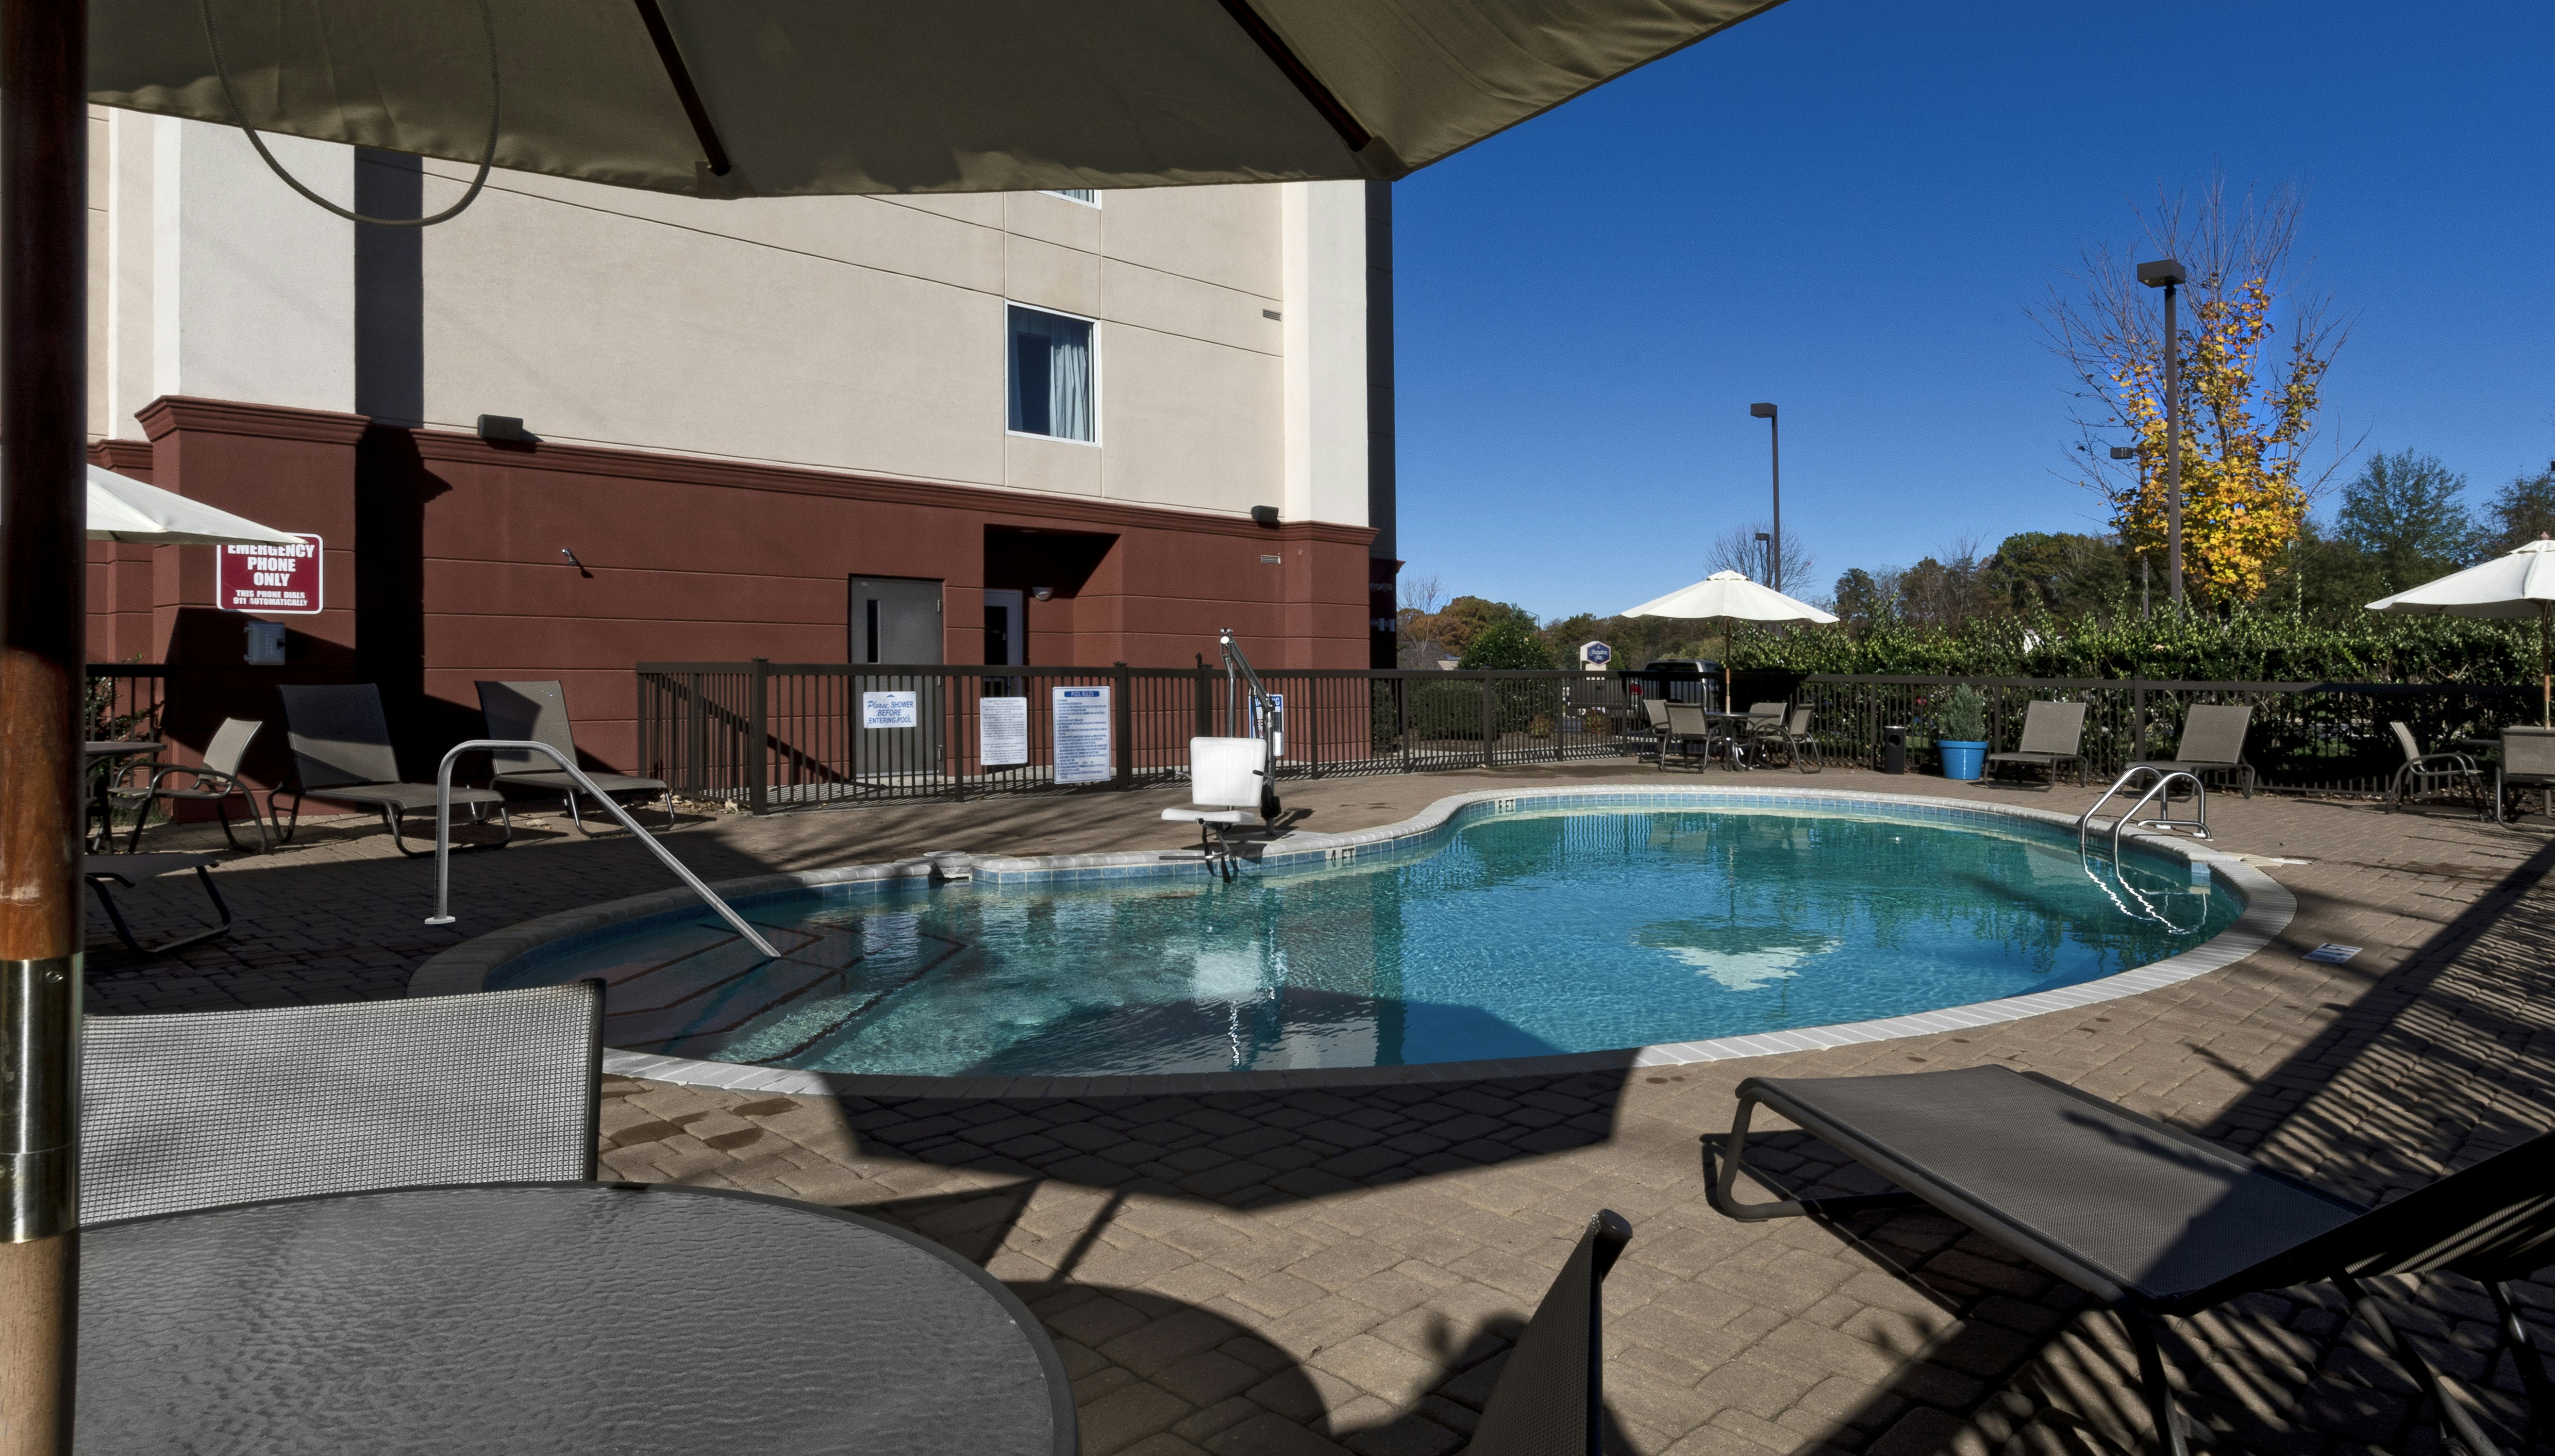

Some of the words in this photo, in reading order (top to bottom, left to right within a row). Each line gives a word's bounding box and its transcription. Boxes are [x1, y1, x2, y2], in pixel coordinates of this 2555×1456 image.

[228, 544, 315, 558] EMERGENCY
[247, 556, 296, 572] PHONE
[253, 572, 290, 587] ONLY
[249, 597, 308, 606] AUTOMATICALLY
